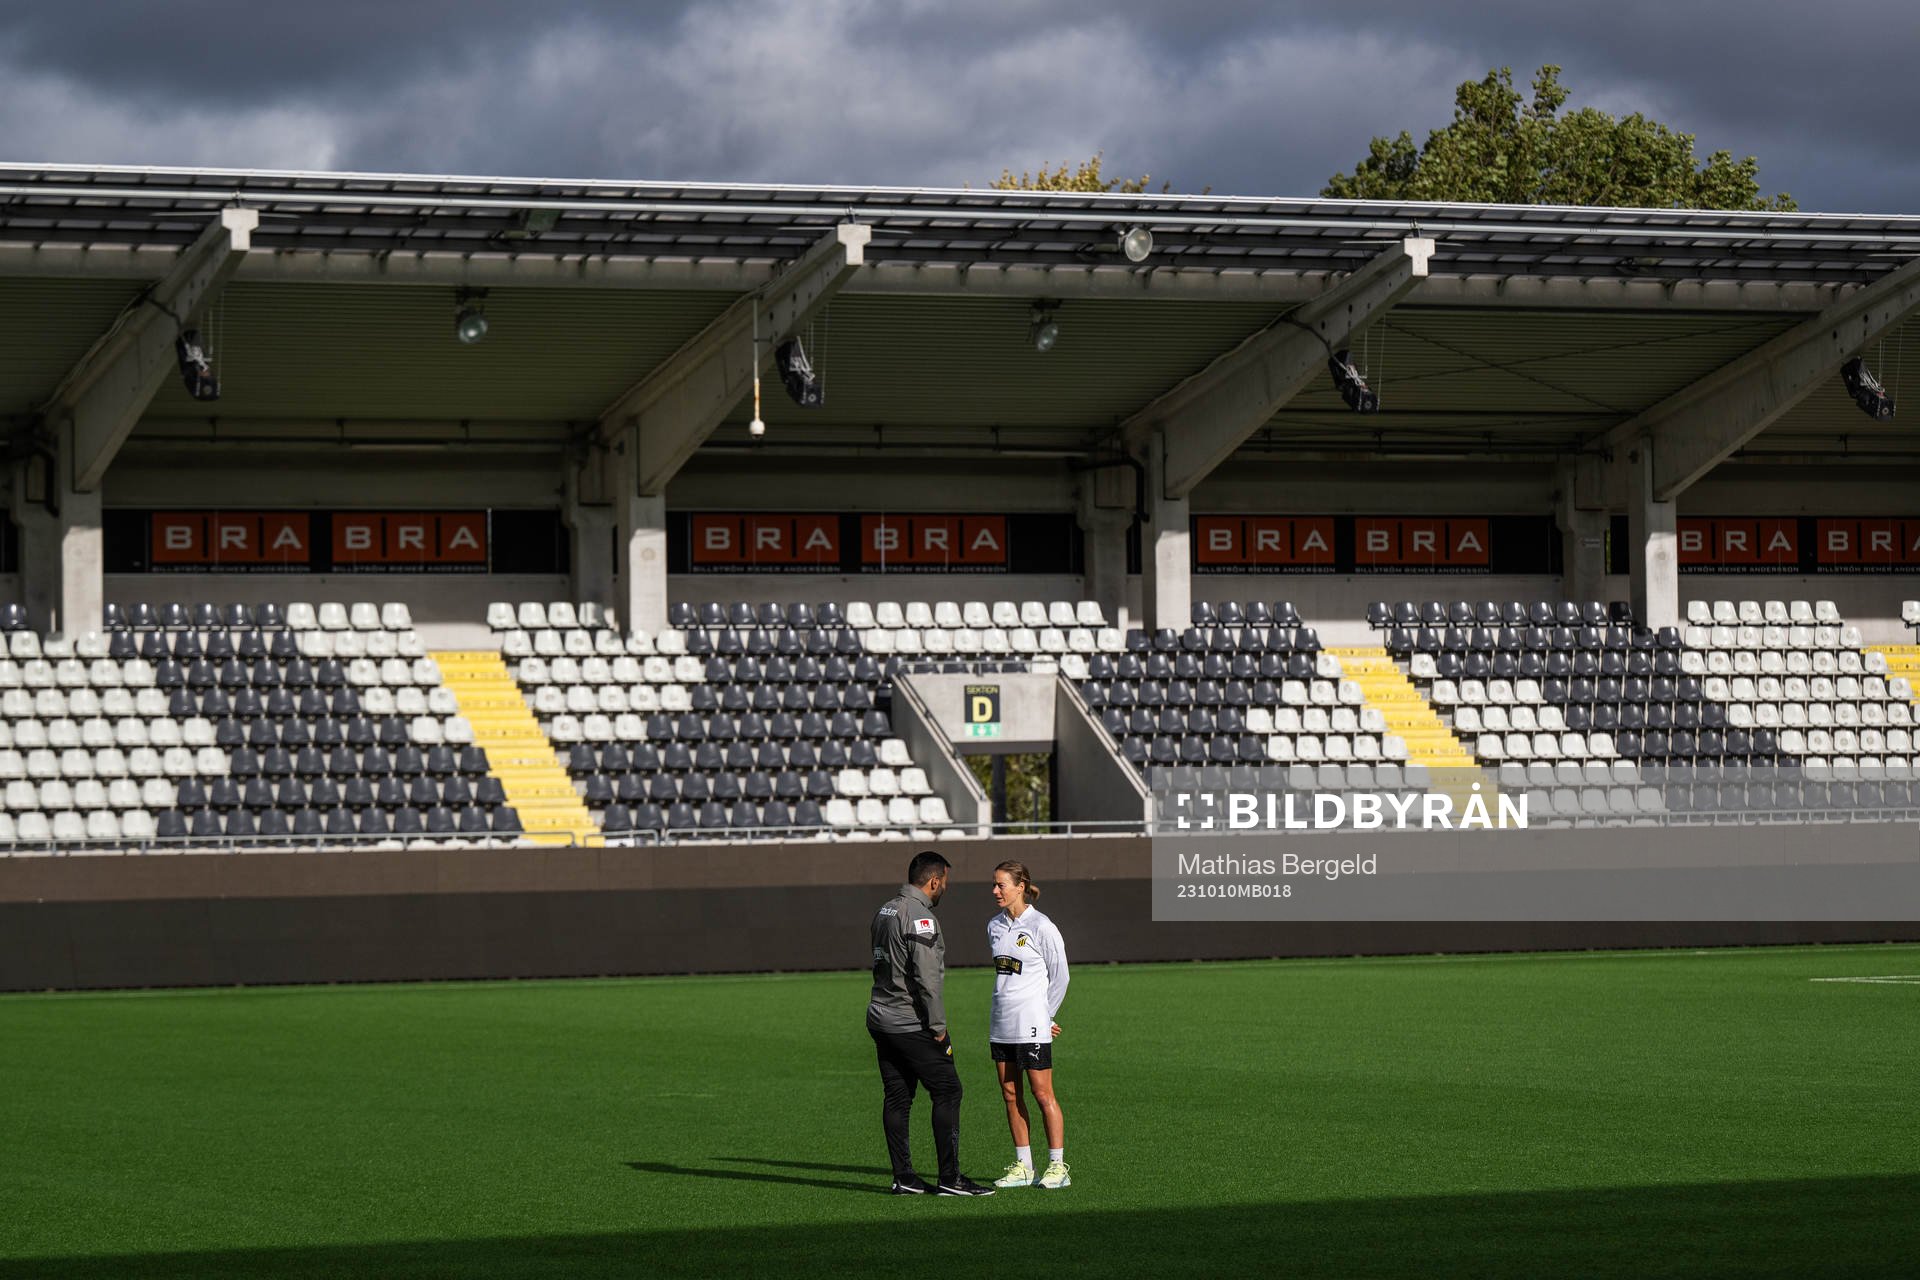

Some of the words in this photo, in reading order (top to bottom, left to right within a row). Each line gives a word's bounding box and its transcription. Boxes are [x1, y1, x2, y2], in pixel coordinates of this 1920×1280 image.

[165, 526, 302, 549] BRA
[345, 526, 479, 550] BRA
[705, 527, 832, 550] BRA
[874, 528, 999, 550] BRA
[1209, 529, 1328, 551] BRA
[1366, 530, 1482, 552] BRA
[1681, 530, 1792, 551] BRA
[972, 696, 993, 723] D
[1031, 1027, 1037, 1038] 3
